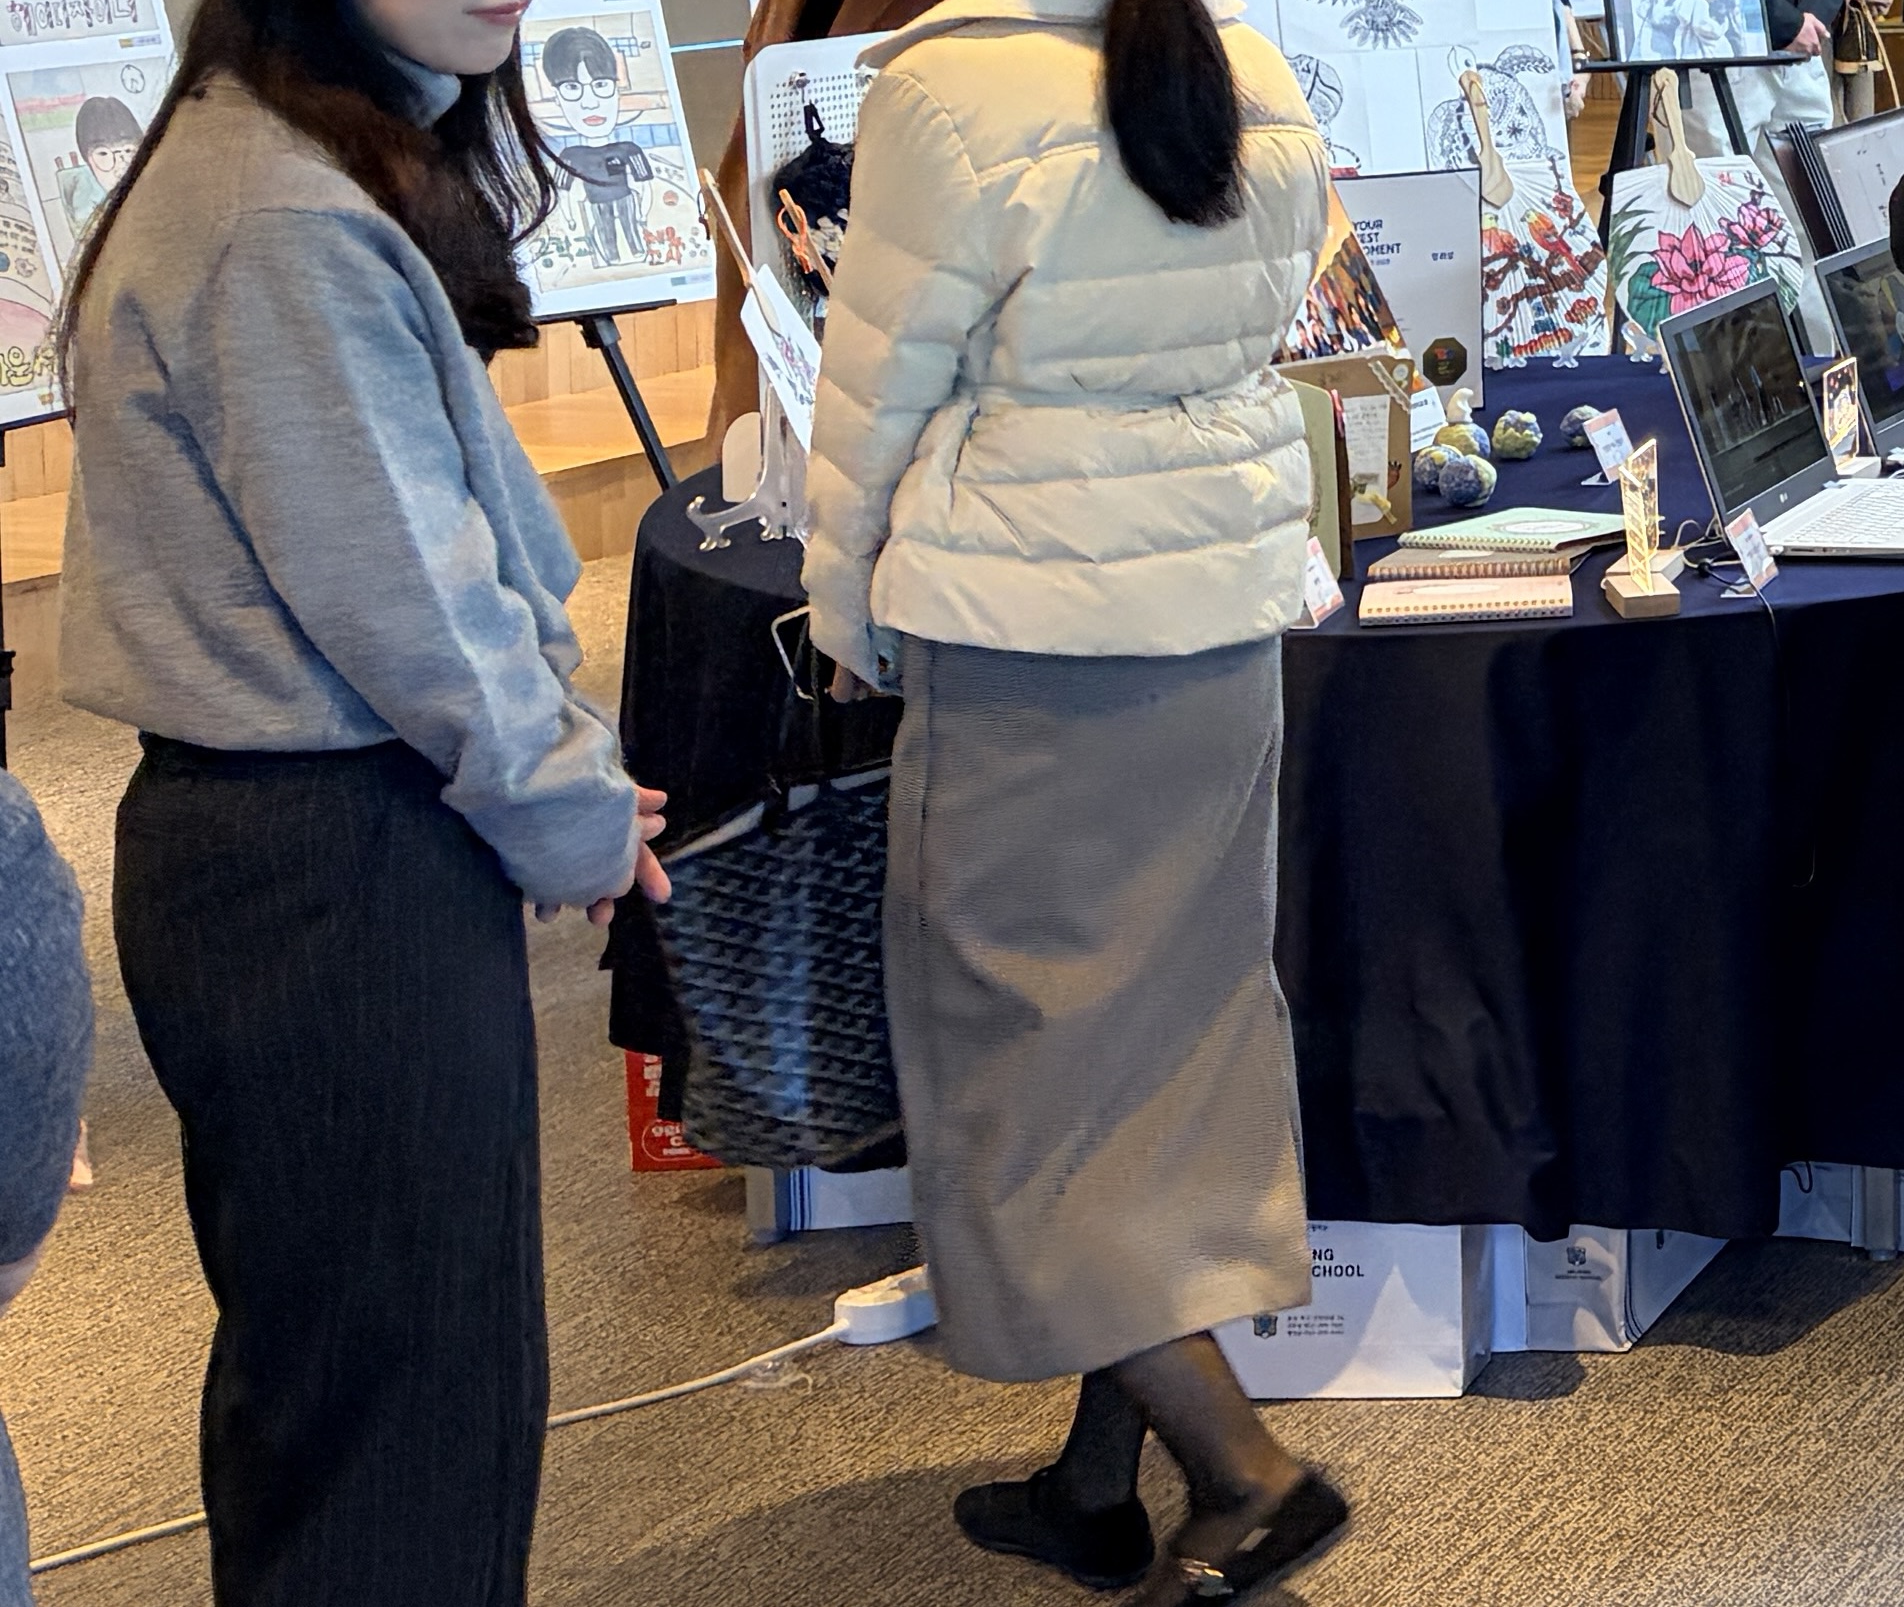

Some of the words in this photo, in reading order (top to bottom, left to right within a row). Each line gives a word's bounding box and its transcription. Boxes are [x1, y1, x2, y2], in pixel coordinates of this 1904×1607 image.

[1357, 232, 1380, 244] EST
[1311, 1248, 1335, 1262] NG
[1311, 1264, 1365, 1278] CHOOL
